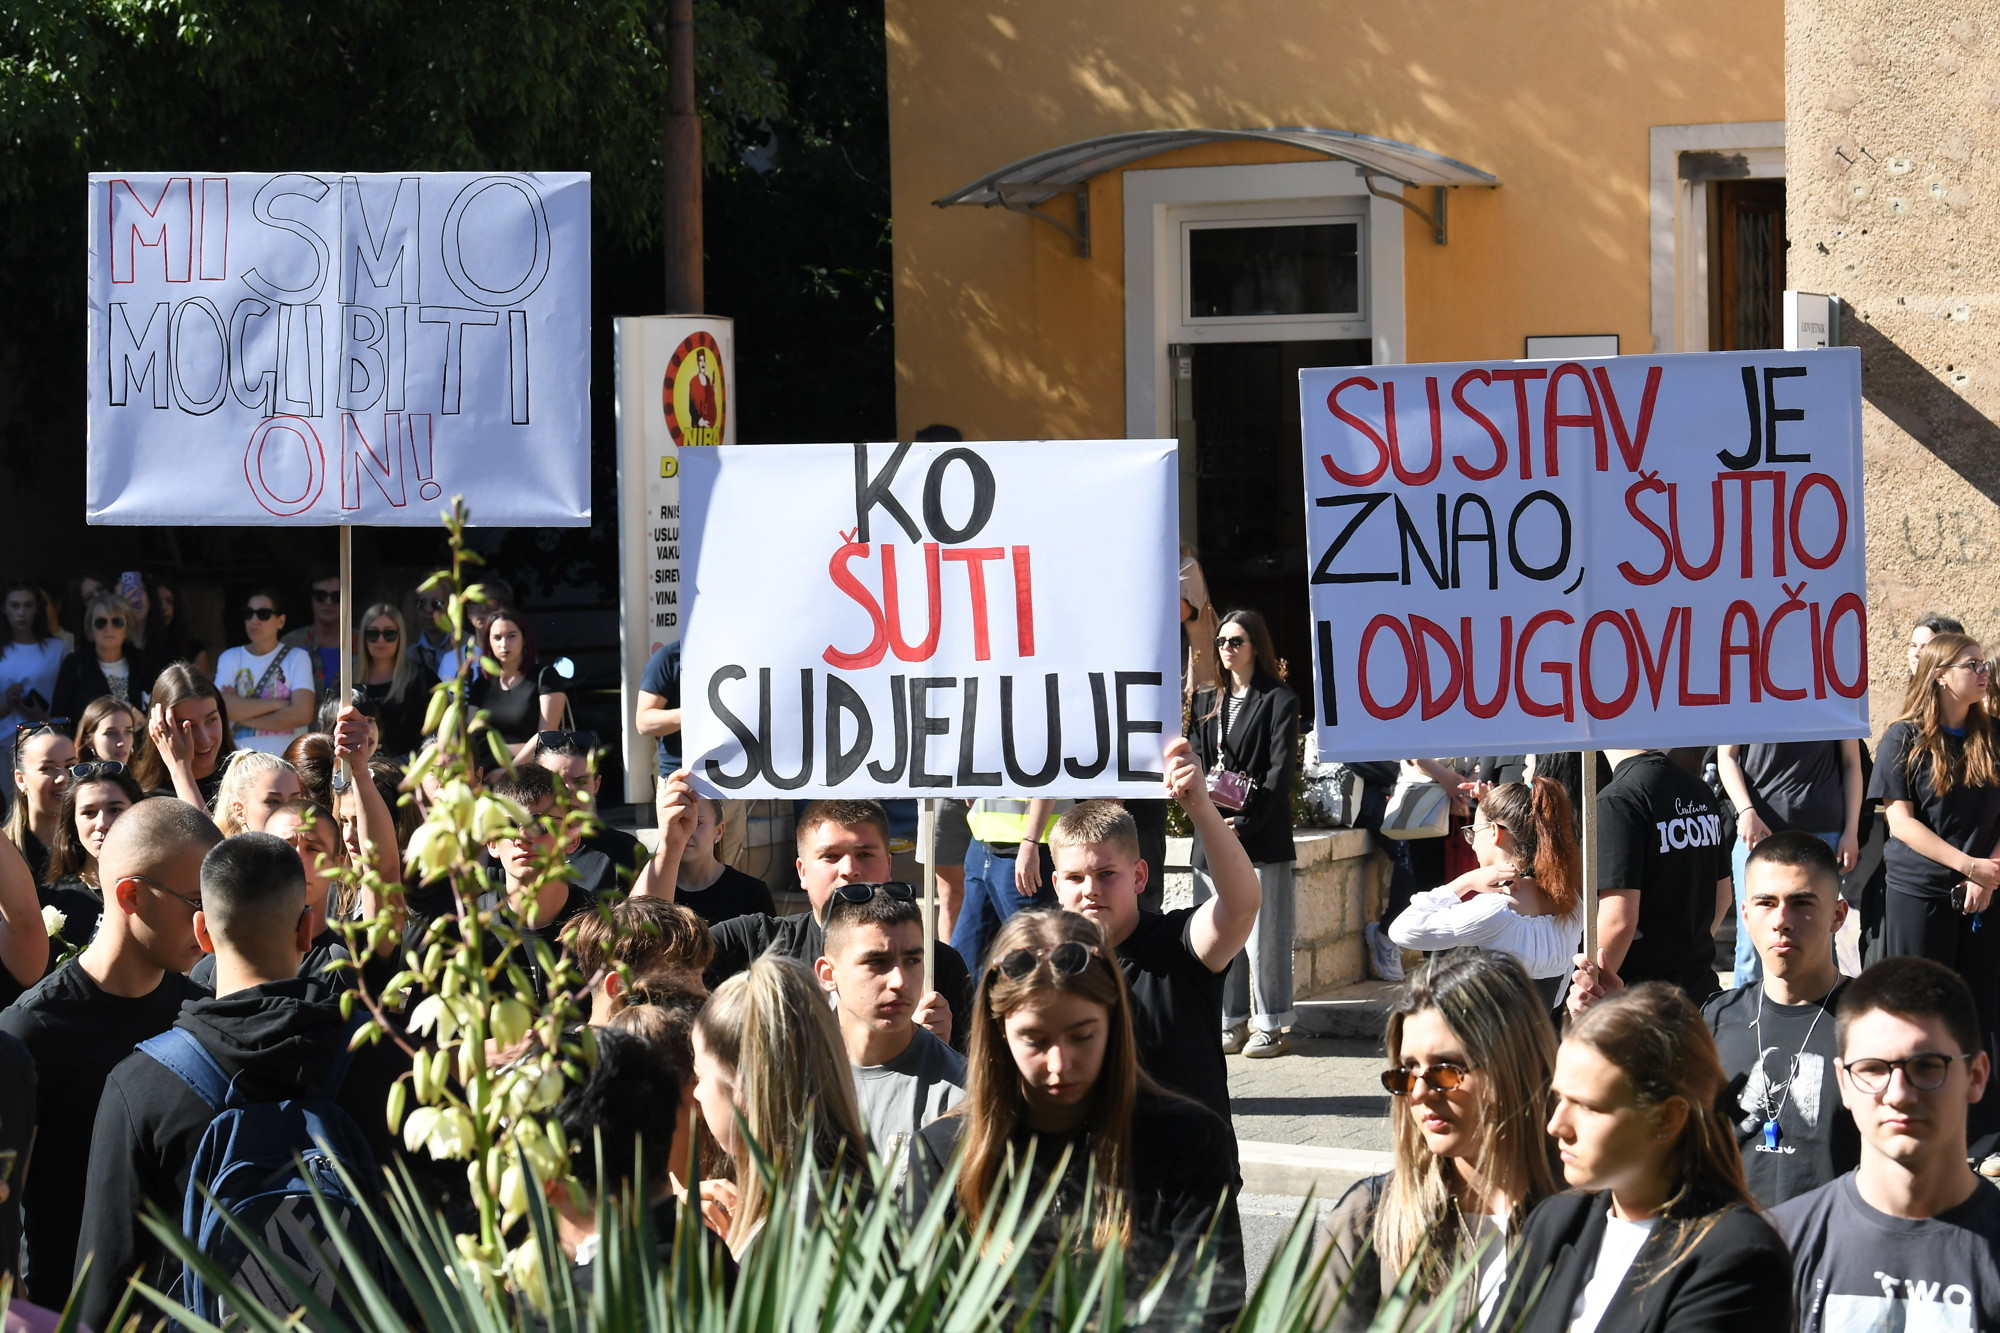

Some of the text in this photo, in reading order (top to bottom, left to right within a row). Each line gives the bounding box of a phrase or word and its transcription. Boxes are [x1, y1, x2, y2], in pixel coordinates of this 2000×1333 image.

[109, 174, 551, 306] MI SMO
[109, 296, 530, 426] MOGLI BITI
[243, 413, 442, 517] ON!
[1320, 362, 1811, 487] SUSTAV JE
[854, 443, 997, 545] KO
[1310, 470, 1848, 595] ZNAO, ŠUTIO
[655, 590, 677, 605] VINA
[656, 612, 677, 627] MED
[822, 526, 1035, 670] ŠUTI
[1317, 581, 1868, 726] I ODUGOVLAČIO
[705, 664, 1164, 790] SUDJELUJE
[1675, 797, 1708, 816] Couture
[1873, 1270, 1972, 1309] TWO
